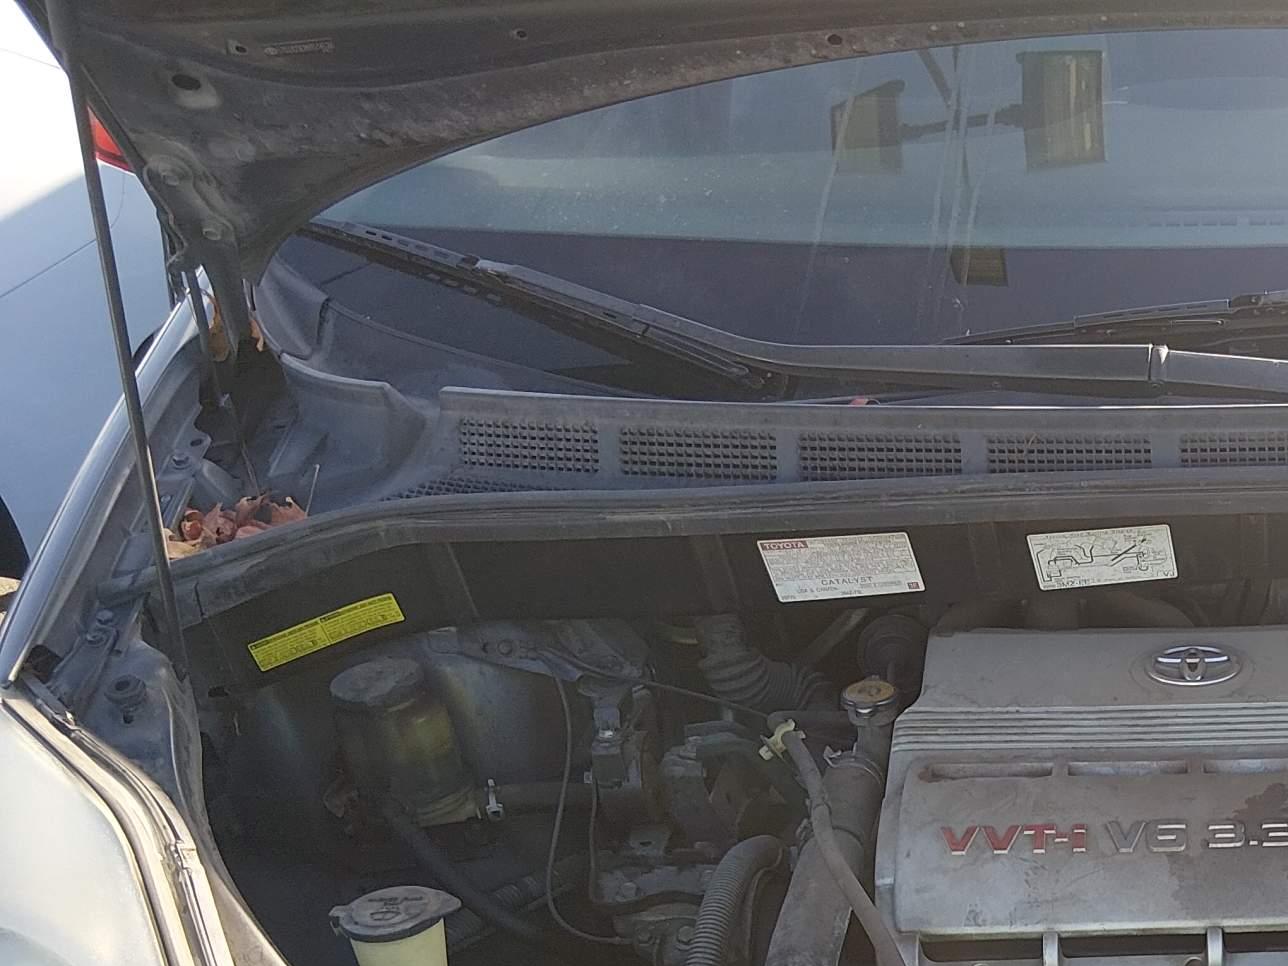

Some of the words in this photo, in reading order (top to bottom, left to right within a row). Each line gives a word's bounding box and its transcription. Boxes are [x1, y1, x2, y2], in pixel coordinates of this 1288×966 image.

[764, 541, 805, 550] TOYOTA
[821, 576, 874, 587] CATALYST
[940, 823, 1088, 855] VVT-i
[1104, 819, 1189, 852] V6
